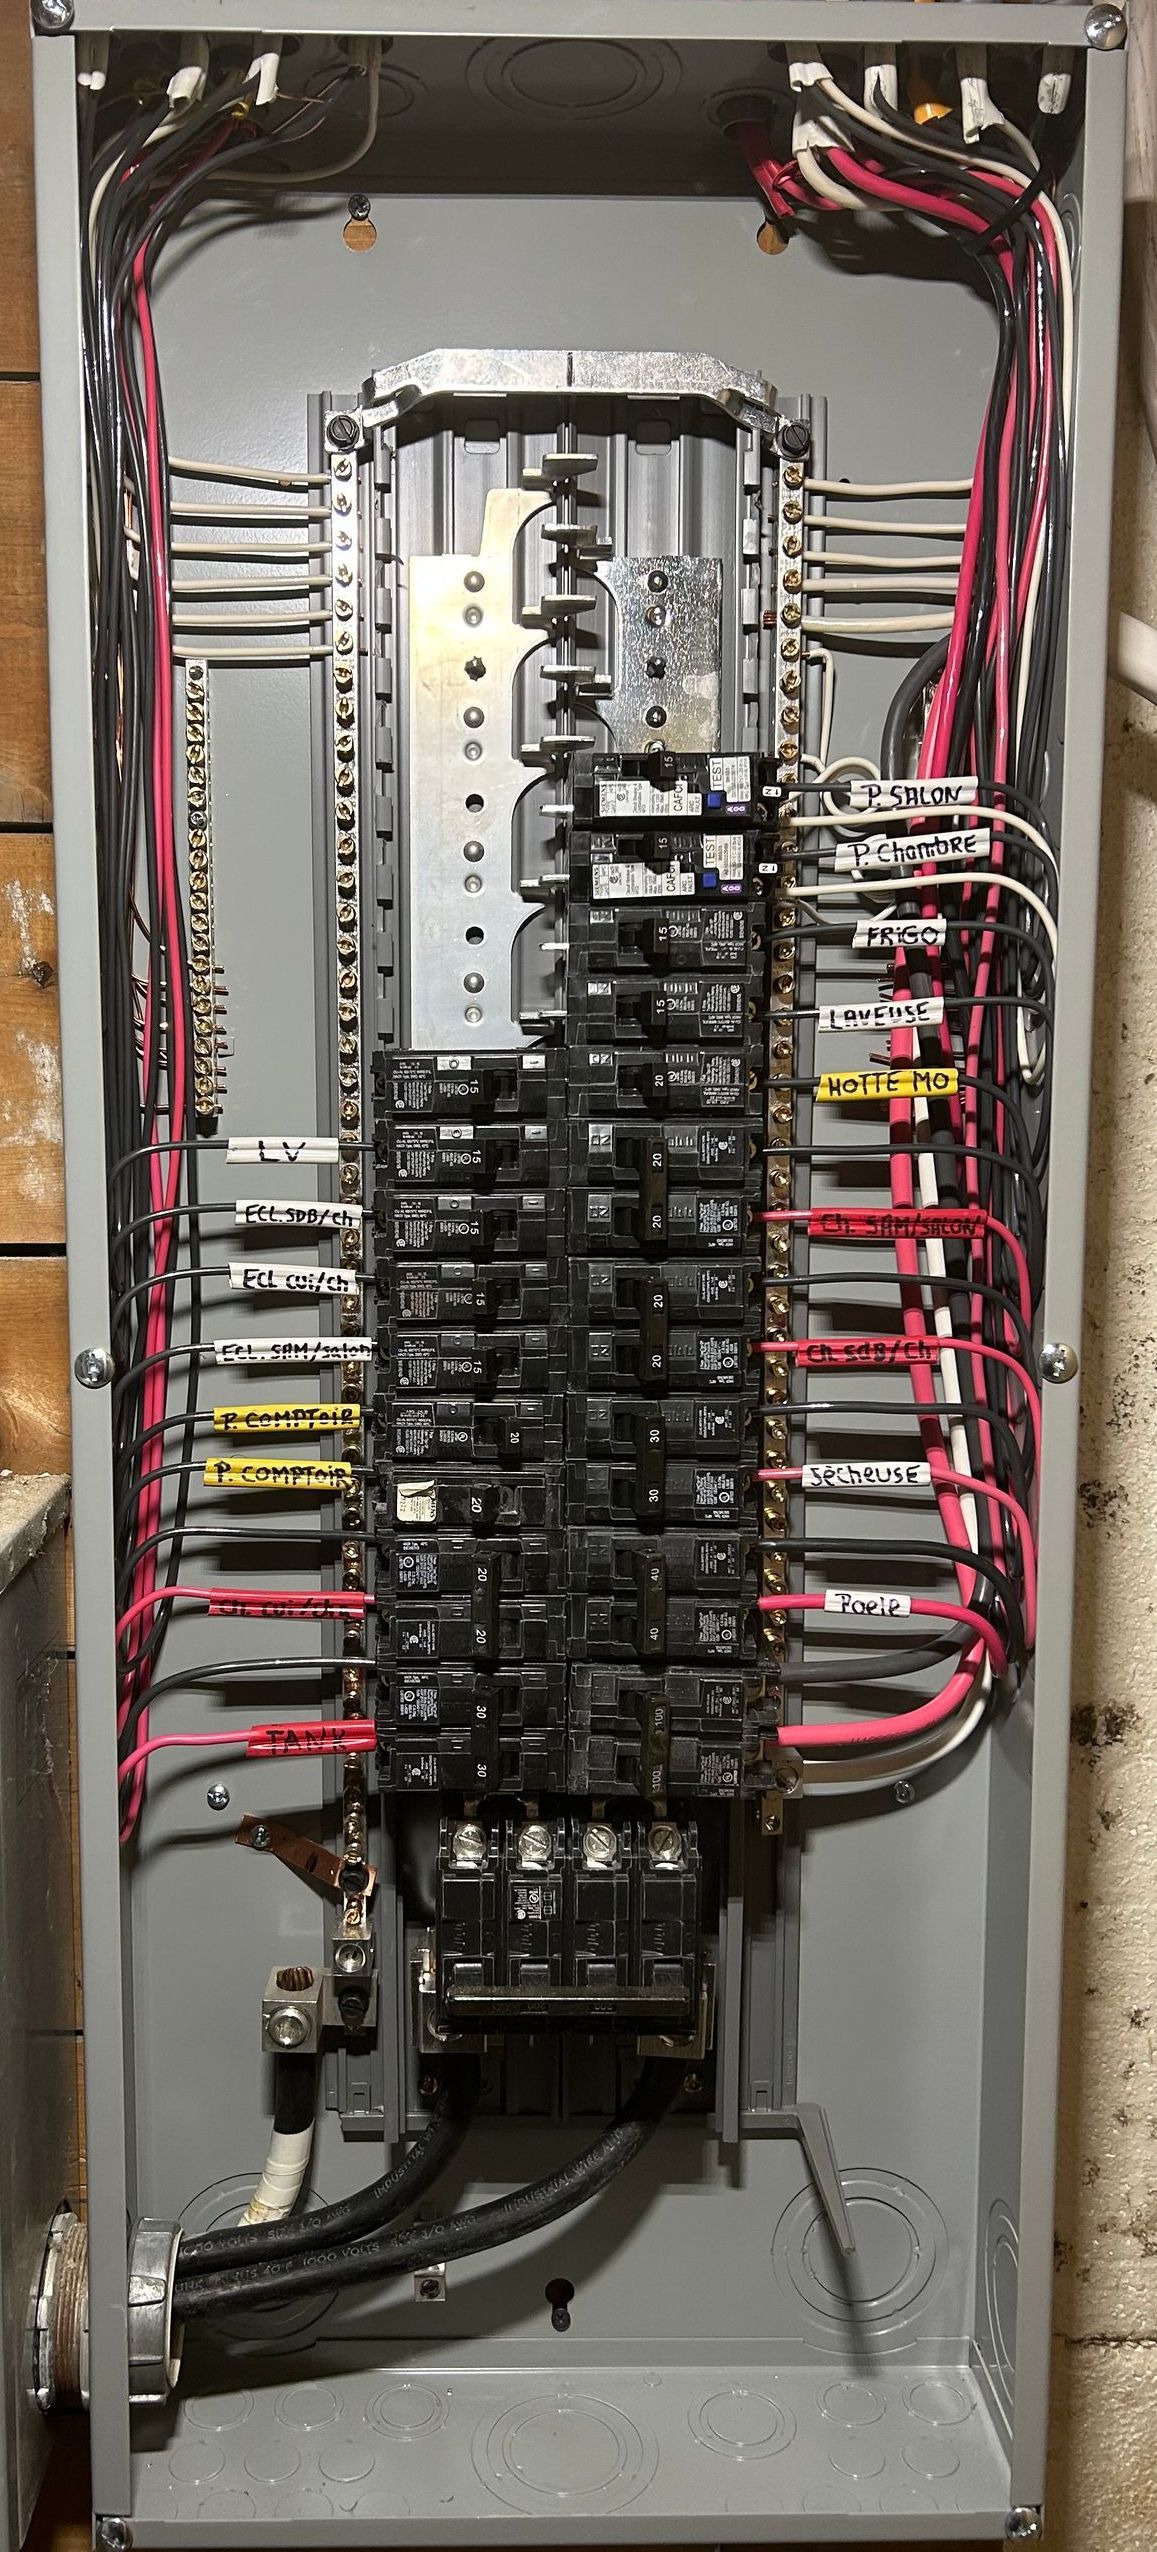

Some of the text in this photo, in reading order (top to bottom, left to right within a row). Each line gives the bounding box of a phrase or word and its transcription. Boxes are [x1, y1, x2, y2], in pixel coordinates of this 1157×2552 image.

[664, 756, 673, 768] 15
[712, 759, 721, 788] TEST
[890, 785, 962, 807] SALON
[659, 837, 668, 849] 15
[706, 838, 715, 867] TEST
[659, 926, 668, 942] 15
[656, 999, 665, 1014] 15
[470, 1079, 479, 1094] 15
[655, 1074, 664, 1087] 20
[828, 1071, 950, 1097] HOTTE MO
[258, 1140, 306, 1162] LV
[472, 1149, 481, 1164] 15
[653, 1153, 662, 1167] 20
[470, 1221, 479, 1235] 15
[653, 1215, 662, 1229] 20
[476, 1292, 485, 1306] 15
[654, 1294, 663, 1308] 20
[473, 1360, 482, 1374] 15
[652, 1354, 662, 1368] 20
[510, 1432, 519, 1444] 20
[650, 1429, 660, 1443] 30
[649, 1489, 659, 1503] 30
[471, 1498, 482, 1513] 20
[477, 1567, 487, 1582] 20
[651, 1567, 660, 1582] 40
[476, 1629, 487, 1644] 20
[650, 1627, 659, 1641] 40
[477, 1705, 487, 1719] 30
[266, 1727, 346, 1754] TANK
[477, 1763, 487, 1778] 30
[303, 2252, 337, 2266] 1000
